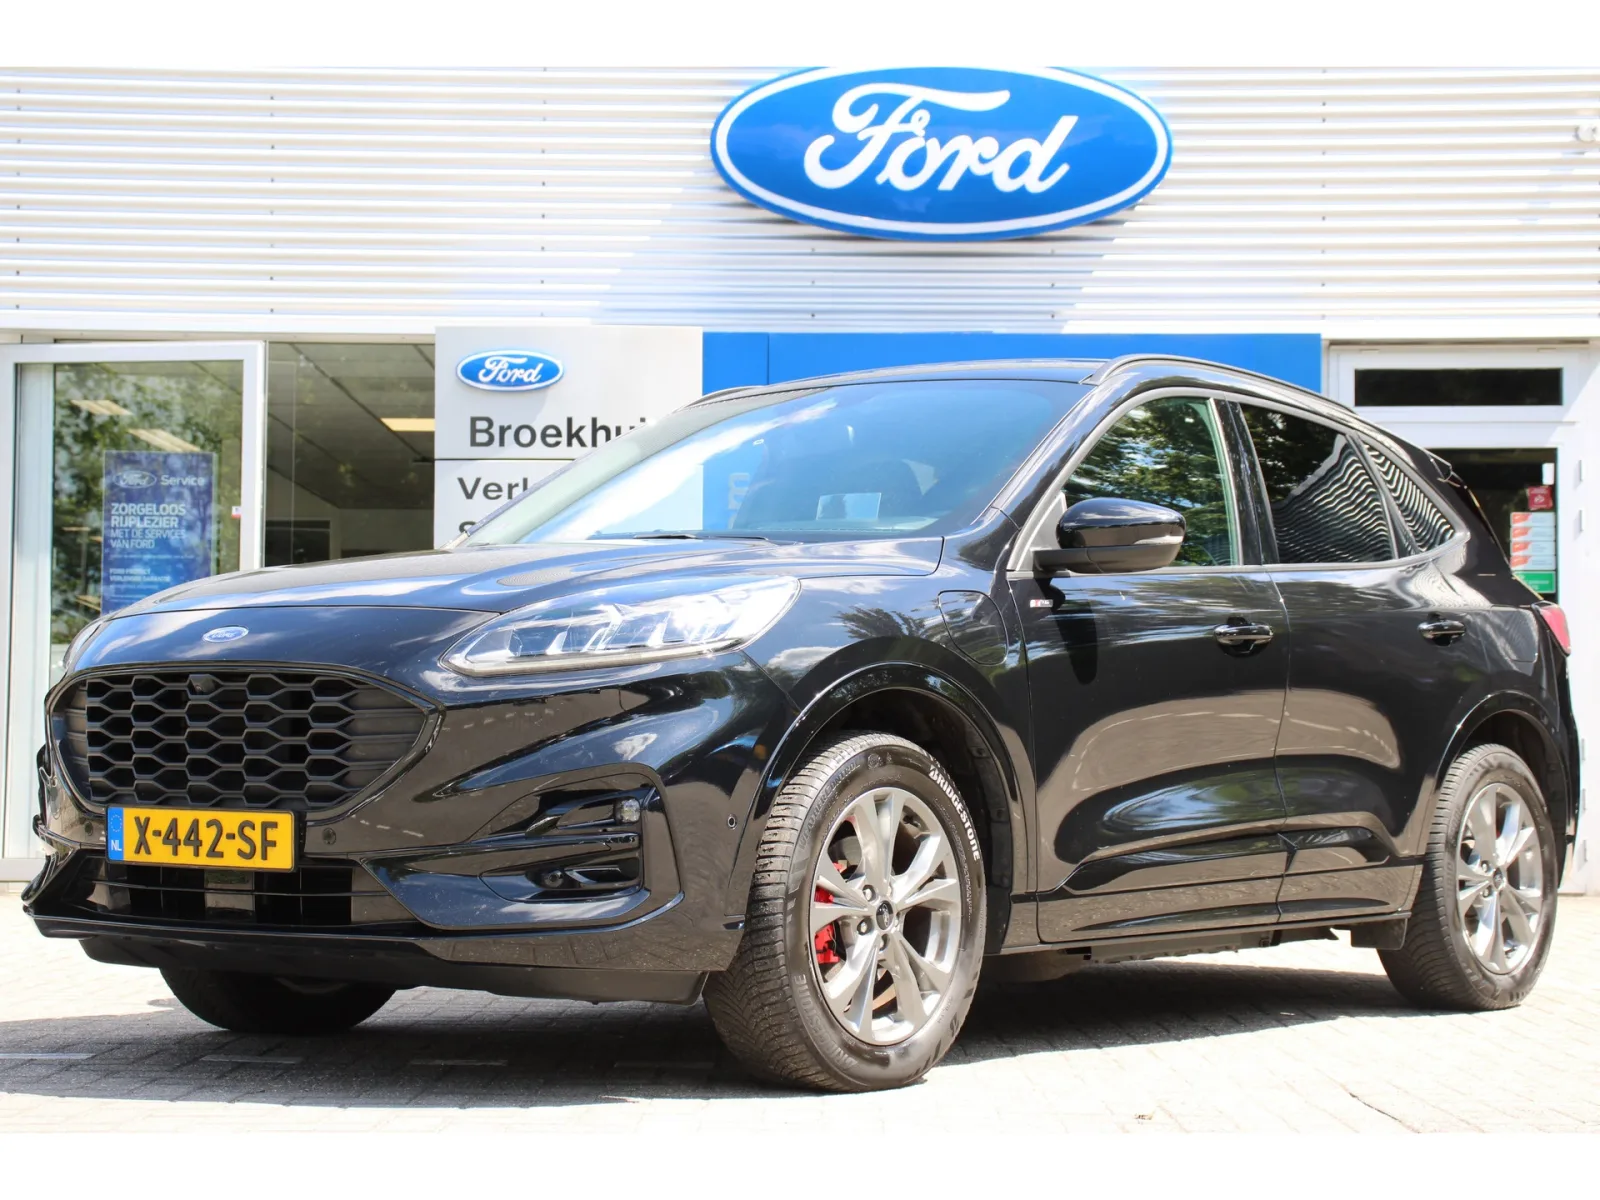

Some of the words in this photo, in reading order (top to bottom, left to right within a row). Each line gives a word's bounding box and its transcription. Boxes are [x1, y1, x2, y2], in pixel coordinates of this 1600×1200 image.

[803, 82, 1079, 194] Ford
[477, 355, 545, 383] Ford
[469, 416, 647, 448] Broekh
[160, 474, 206, 486] Service
[110, 502, 187, 516] ZORGELOOS
[110, 515, 180, 528] RIJPLEZIER
[110, 528, 130, 538] MET
[131, 528, 143, 538] DE
[145, 528, 186, 539] SERVICES
[110, 539, 129, 548] VAN
[130, 539, 156, 549] FORD
[928, 764, 980, 861] BRIDGESTONE
[110, 839, 123, 852] NL
[134, 816, 279, 861] X-442-SF
